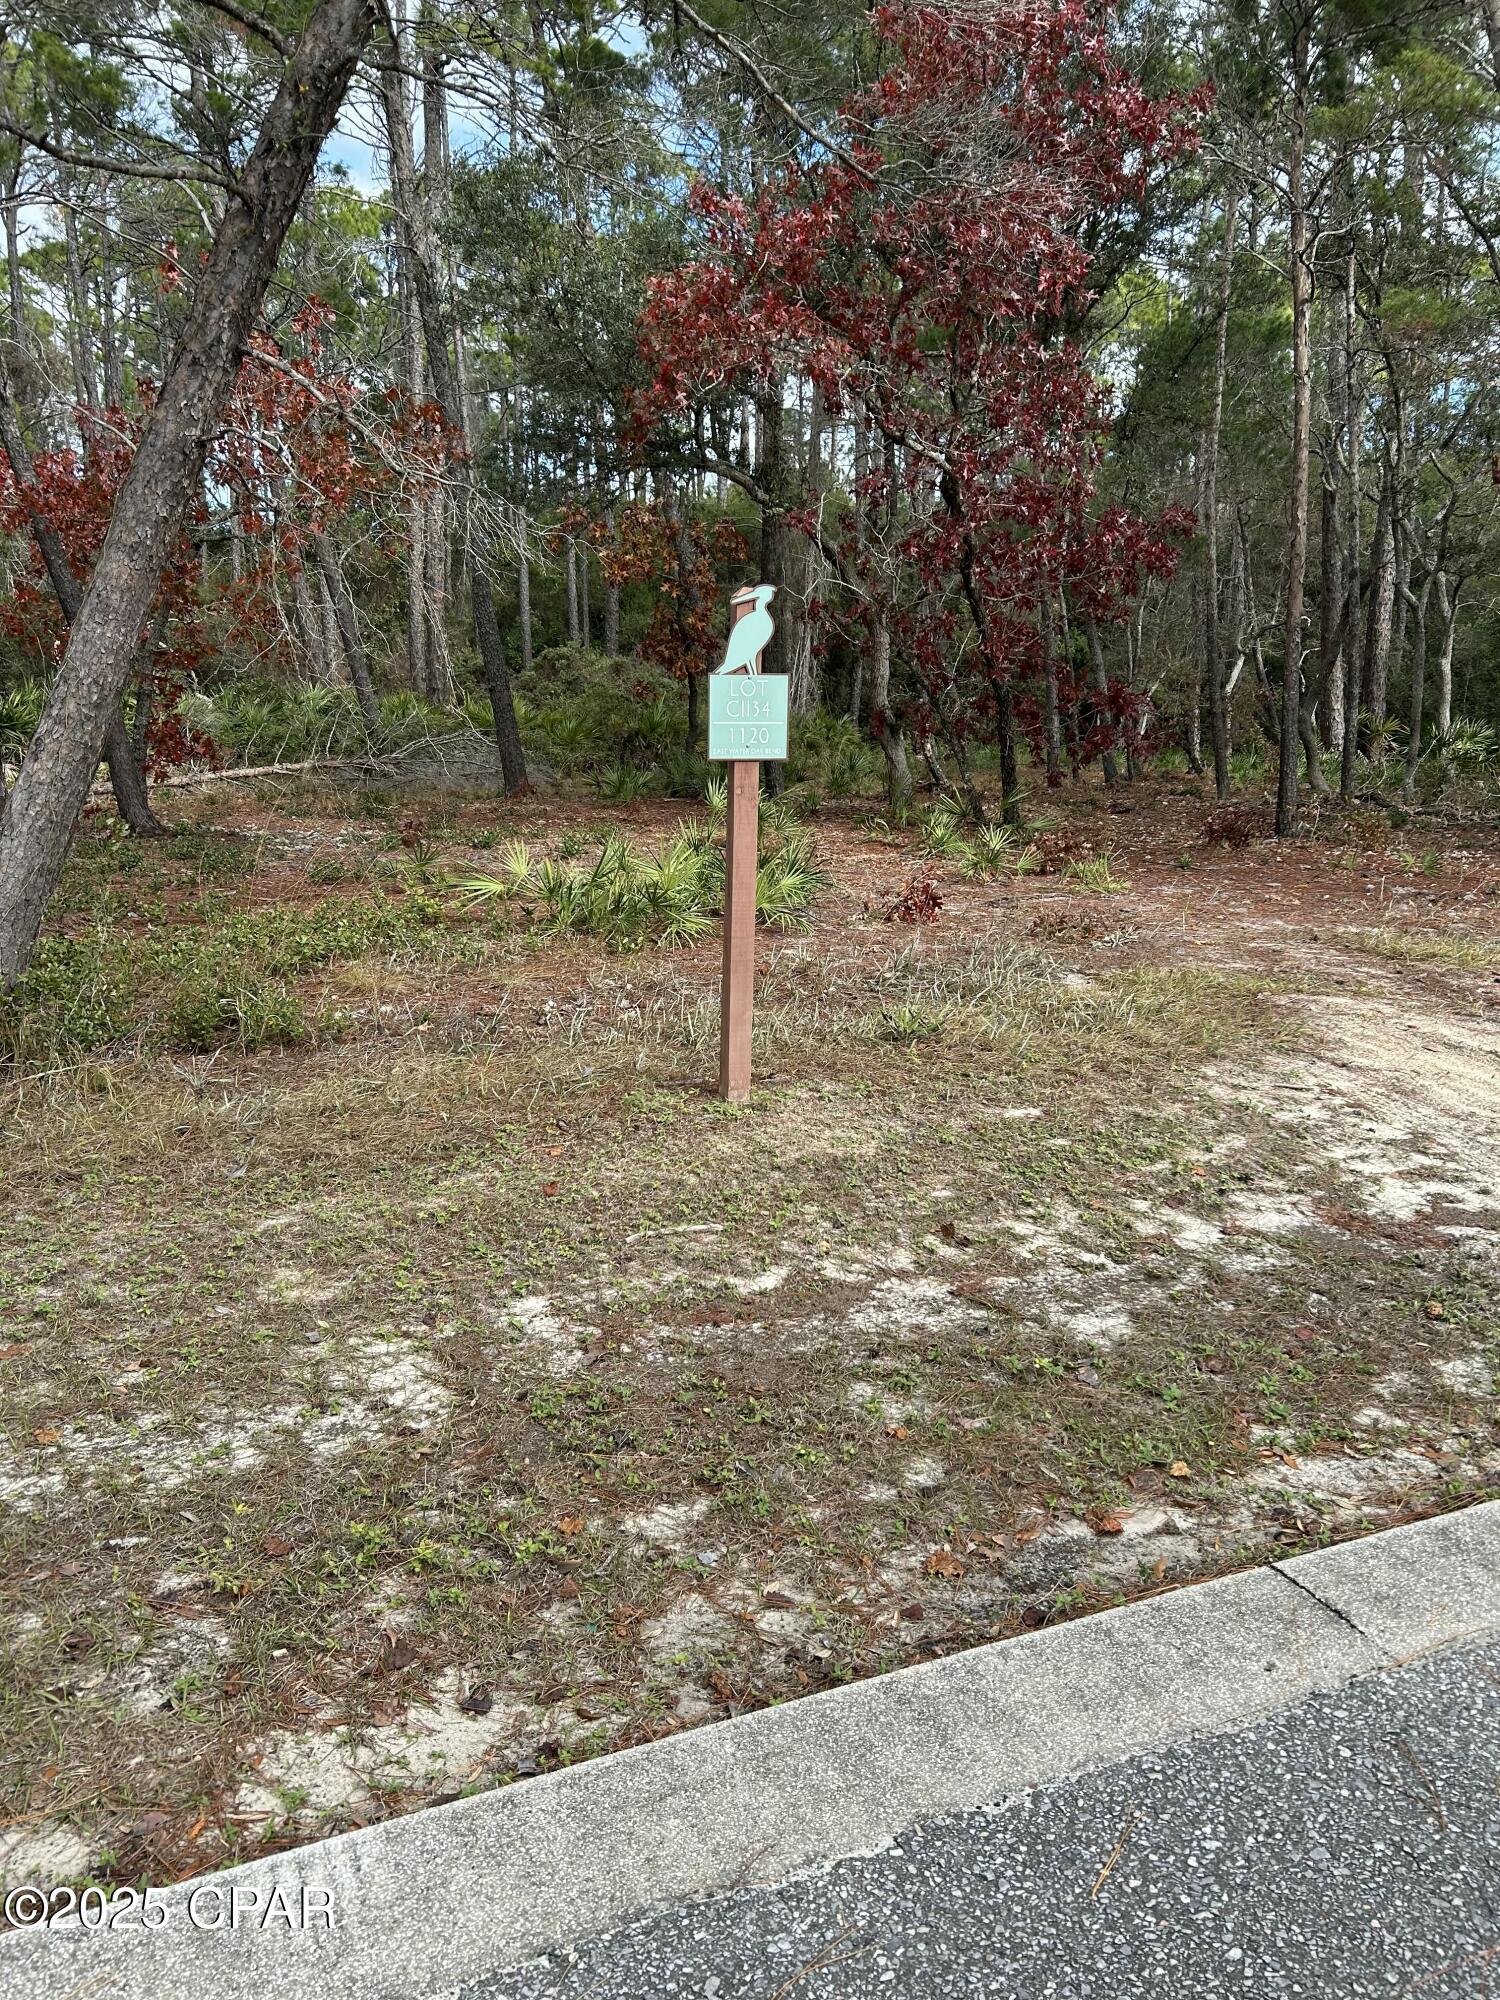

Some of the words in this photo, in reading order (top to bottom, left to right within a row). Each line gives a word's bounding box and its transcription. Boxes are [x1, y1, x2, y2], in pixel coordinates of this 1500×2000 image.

[730, 679, 769, 697] LOT
[726, 700, 770, 718] C1134
[729, 727, 769, 744] 1120
